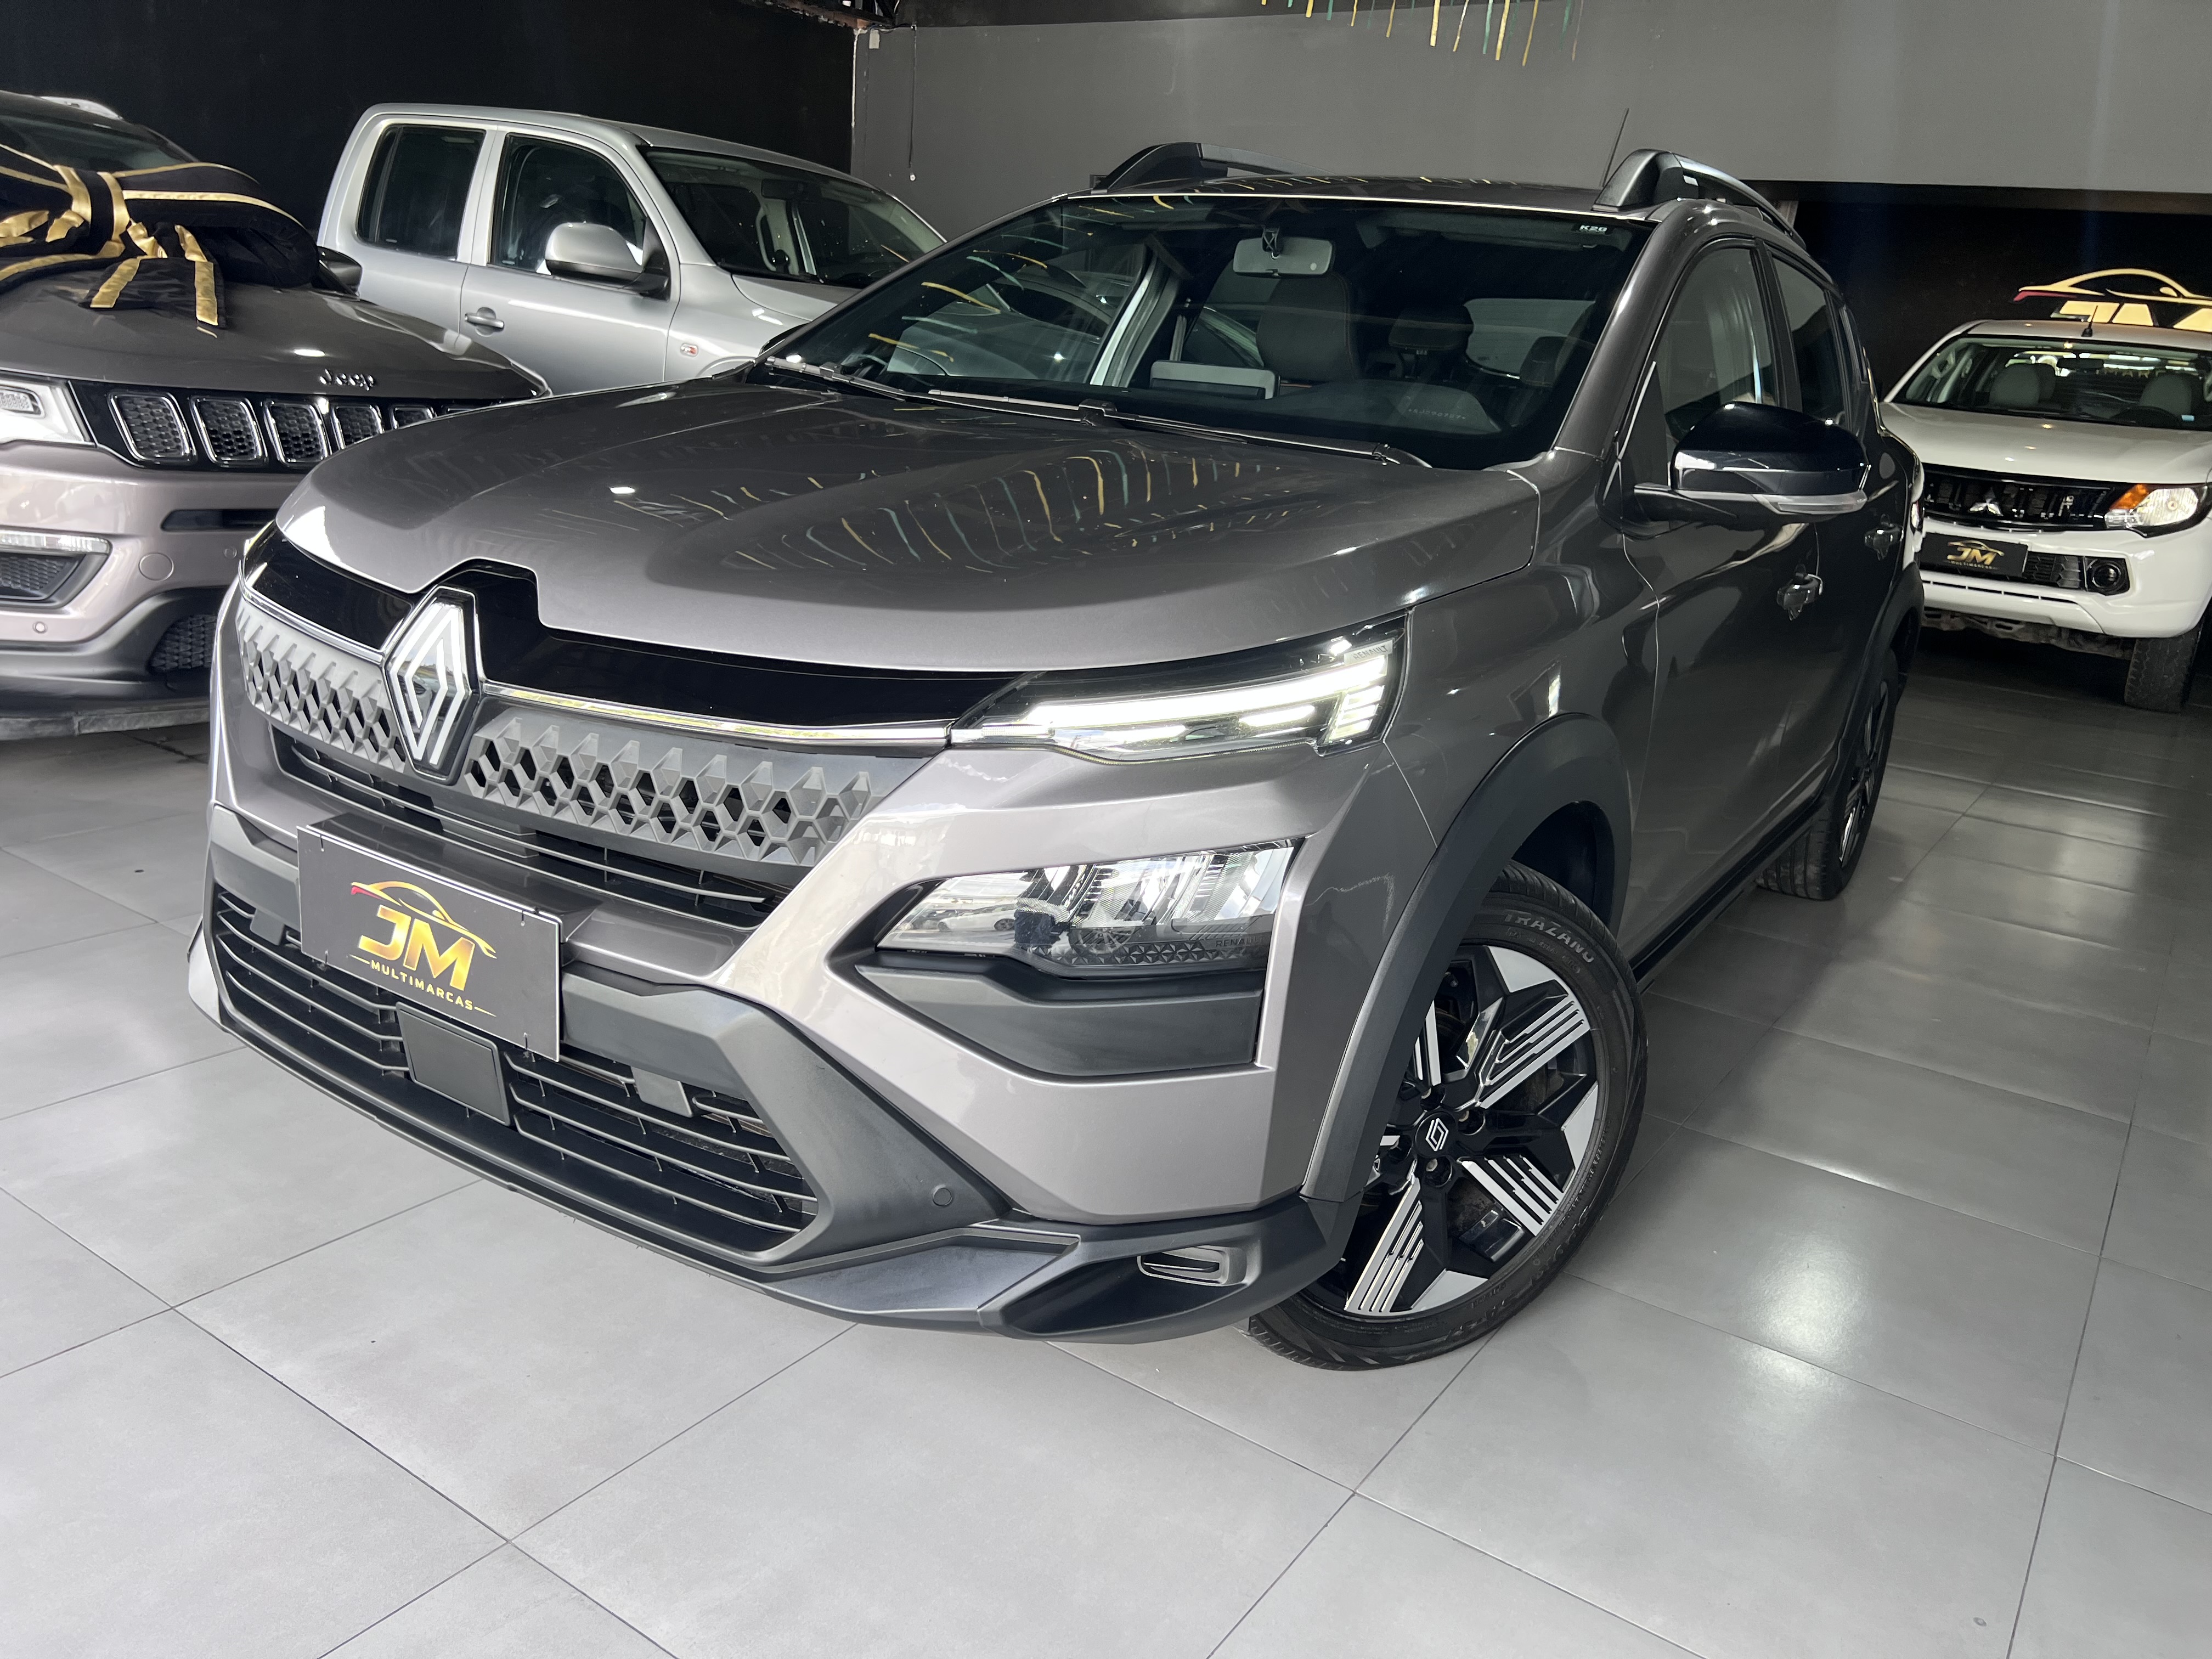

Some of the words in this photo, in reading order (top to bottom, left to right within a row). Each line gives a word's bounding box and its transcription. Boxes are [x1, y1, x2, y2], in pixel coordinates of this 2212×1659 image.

[319, 363, 374, 391] Jeep
[1946, 546, 1997, 566] JM
[1352, 645, 1388, 660] RENAULT
[358, 904, 476, 991] JM
[370, 959, 473, 1012] MULTIMARCAS
